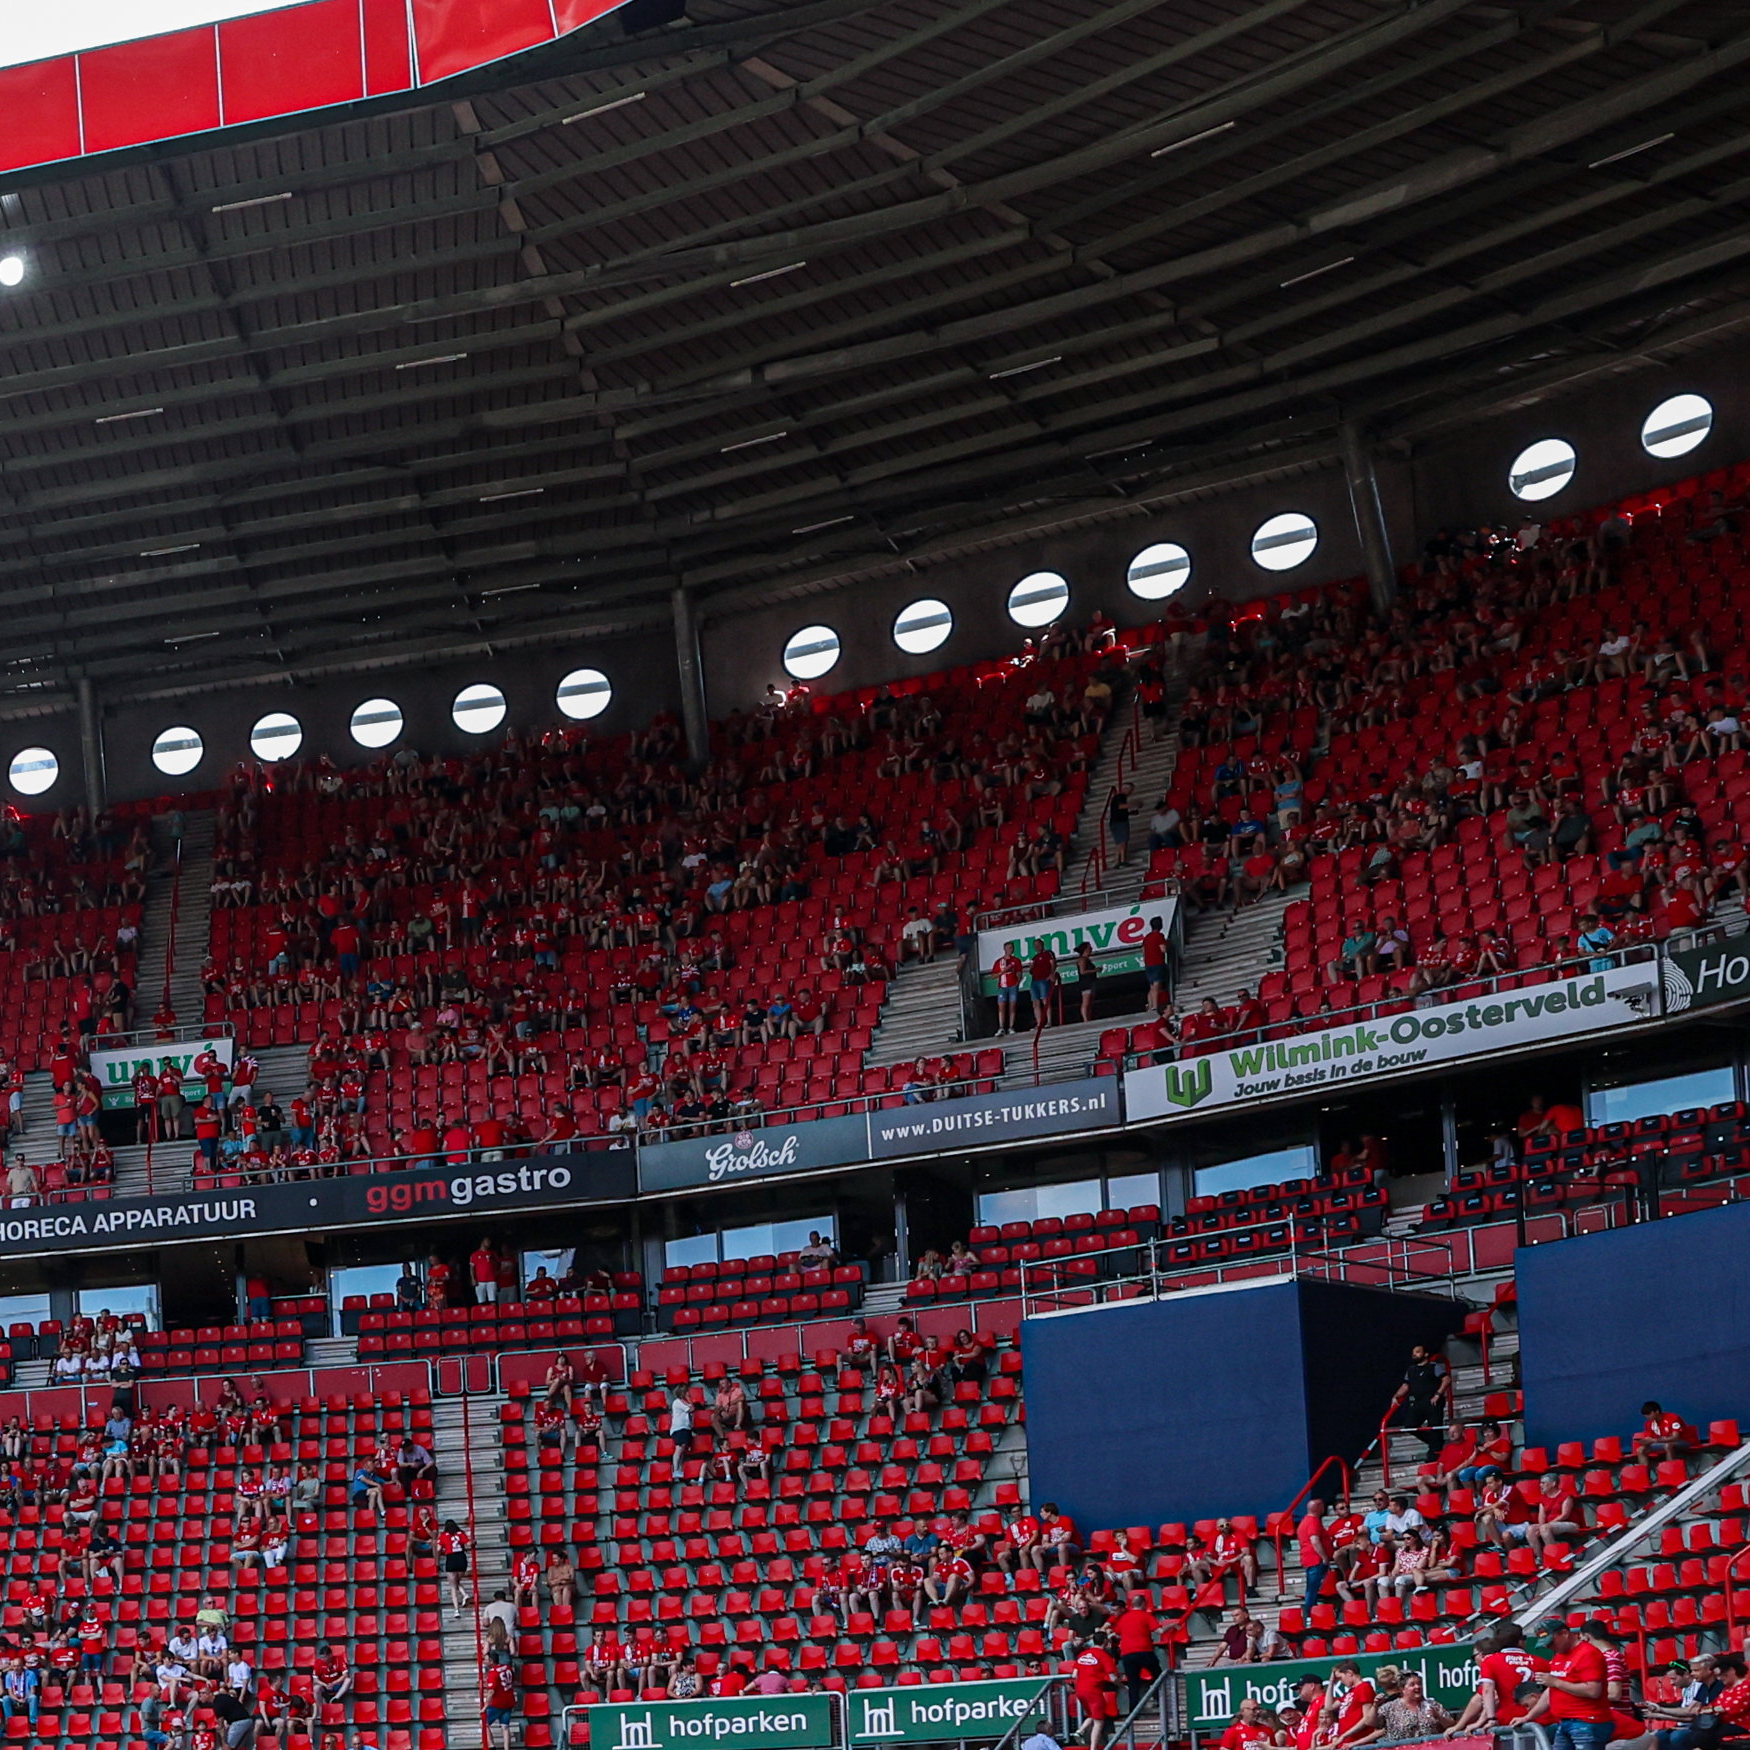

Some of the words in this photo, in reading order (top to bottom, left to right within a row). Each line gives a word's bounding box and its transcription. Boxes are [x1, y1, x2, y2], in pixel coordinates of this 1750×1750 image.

[1229, 977, 1606, 1079] Wilmink-Oosterveld
[1233, 1077, 1280, 1098] Jouw
[1284, 1069, 1327, 1090] basis
[1330, 1064, 1347, 1081] in
[1350, 1060, 1374, 1077] de
[1377, 1047, 1428, 1073] bouw
[881, 1092, 1106, 1142] www.DUITSE-TUKKERS.nl
[705, 1134, 798, 1181] Grolsch
[93, 1198, 257, 1235] APPARATUUR
[670, 1711, 807, 1742] hofparken
[910, 1694, 1046, 1730] hofparken
